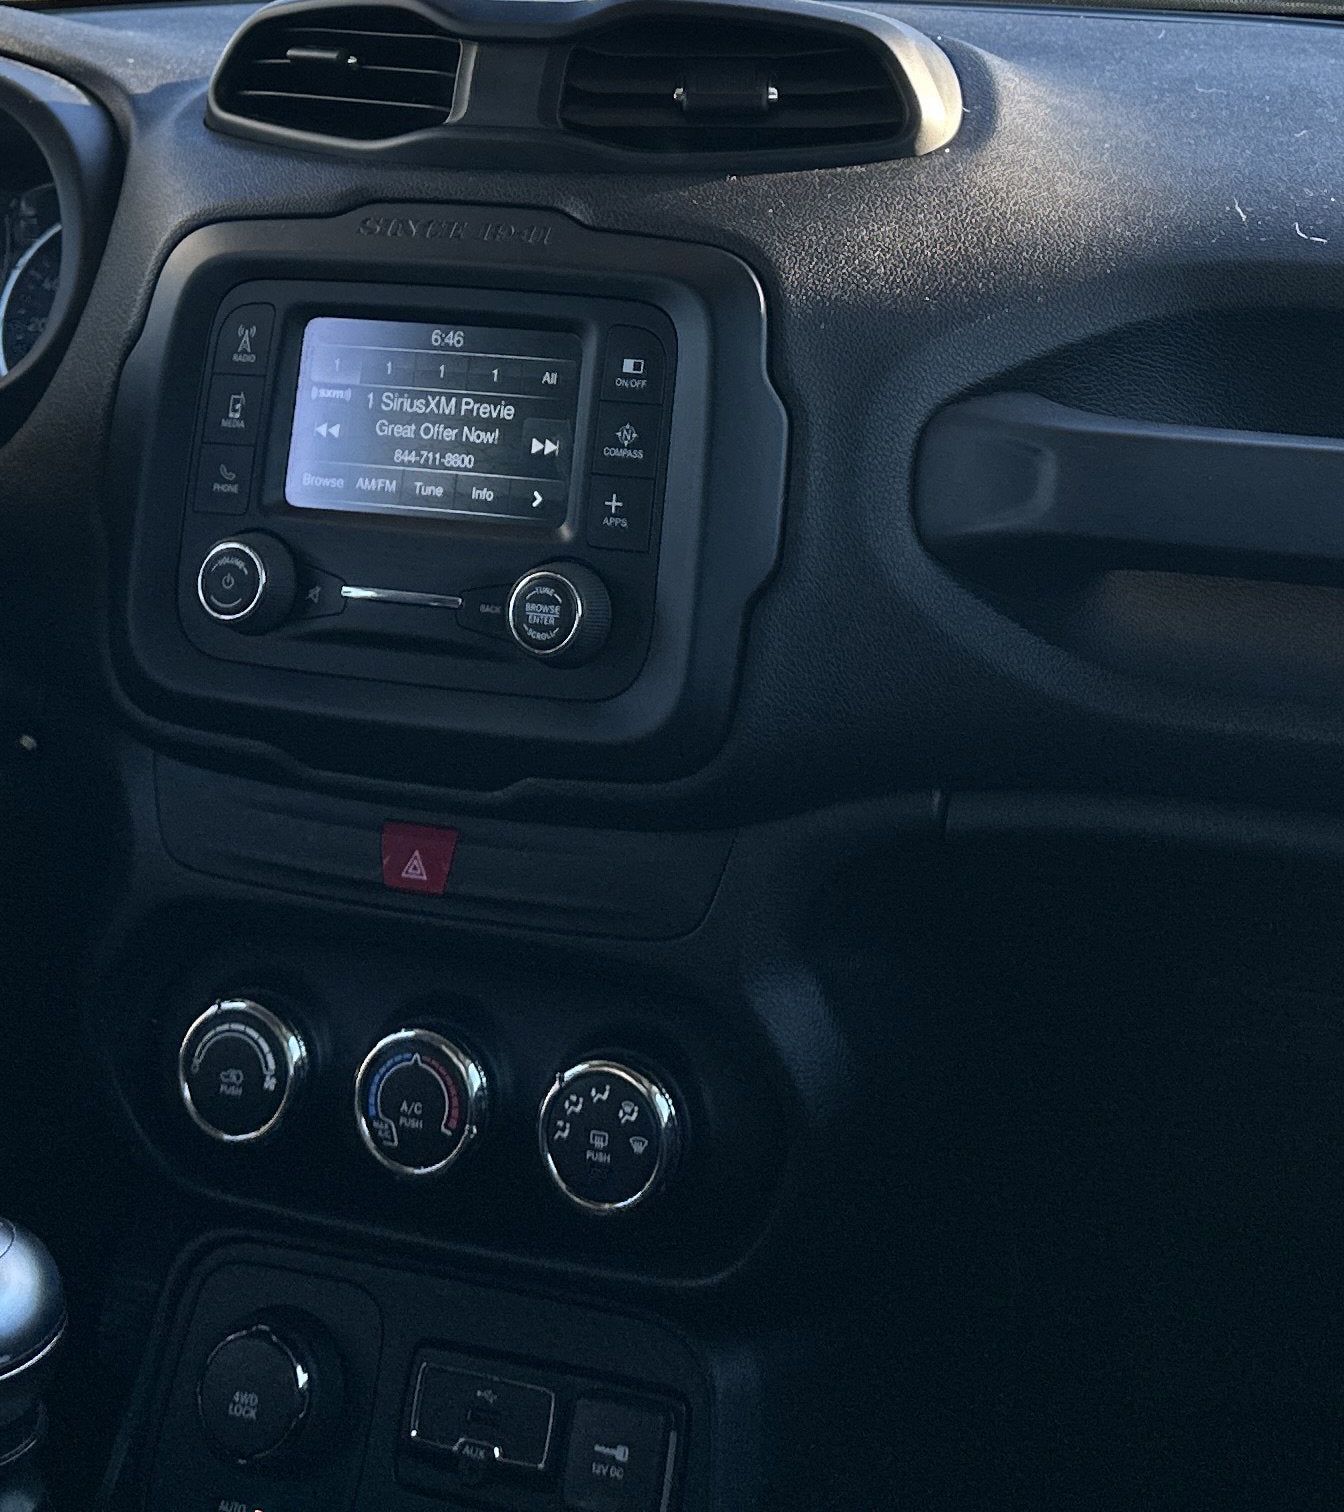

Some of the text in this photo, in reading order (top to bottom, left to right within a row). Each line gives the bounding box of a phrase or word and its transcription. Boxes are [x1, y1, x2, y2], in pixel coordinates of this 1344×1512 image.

[431, 329, 465, 348] 6:46
[232, 353, 256, 363] RADIO
[387, 361, 393, 375] 1
[439, 364, 446, 379] 1
[492, 368, 499, 383] 1
[542, 371, 558, 386] All
[615, 377, 647, 389] ON/OFF
[367, 391, 515, 421] 1 SiriusXM Previe
[375, 419, 500, 445] Great Offer Now!
[603, 446, 644, 460] COMPASS
[302, 472, 344, 489] Browse
[414, 482, 444, 498] Tune
[471, 486, 494, 502] Info
[602, 516, 628, 528] APPS
[535, 586, 555, 597] TUNE
[525, 602, 561, 615] BROWSE
[528, 614, 555, 626] ENTER
[526, 628, 556, 641] SCROLL
[399, 1099, 423, 1115] A/C
[398, 1115, 423, 1129] PUSH
[586, 1149, 611, 1163] PUSH
[233, 1391, 258, 1406] 4WD
[228, 1402, 257, 1419] LOCK
[462, 1444, 485, 1460] AUX
